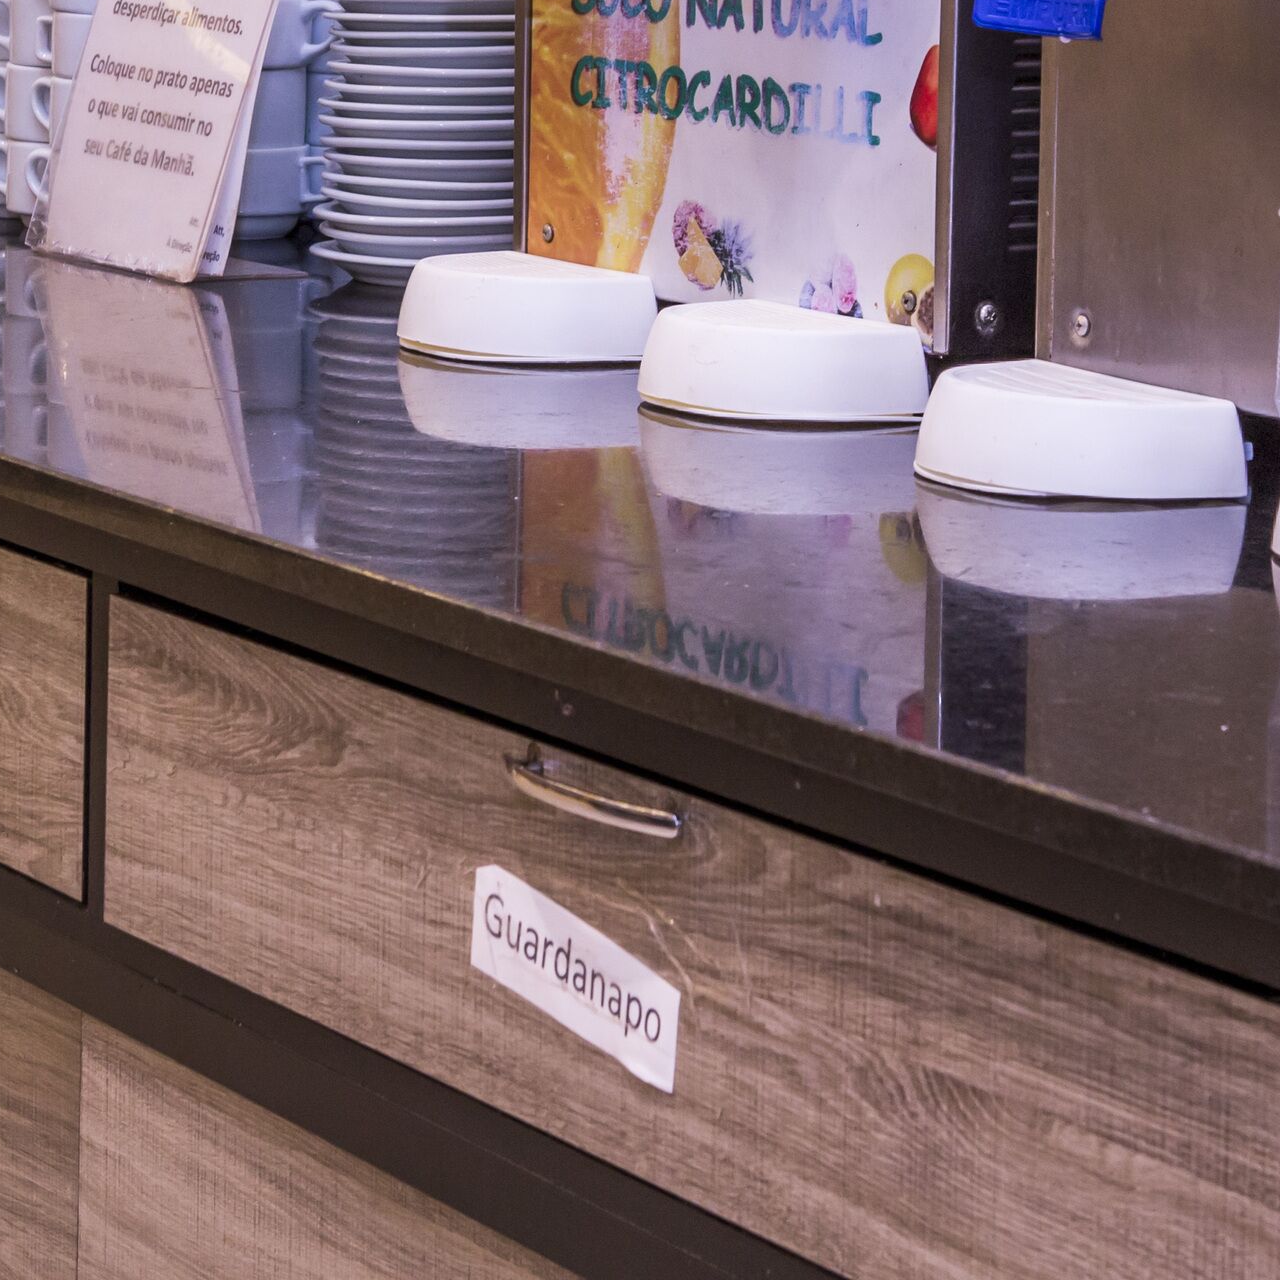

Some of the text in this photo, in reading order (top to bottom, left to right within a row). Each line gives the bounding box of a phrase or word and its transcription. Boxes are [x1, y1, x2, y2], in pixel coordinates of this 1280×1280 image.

[181, 6, 244, 36] alimentos.
[90, 53, 235, 98] Coloque no prato apenas
[88, 98, 213, 137] o que vai consumir no
[84, 138, 195, 177] seu Café da Manhã.
[484, 894, 662, 1043] Guardanapo
